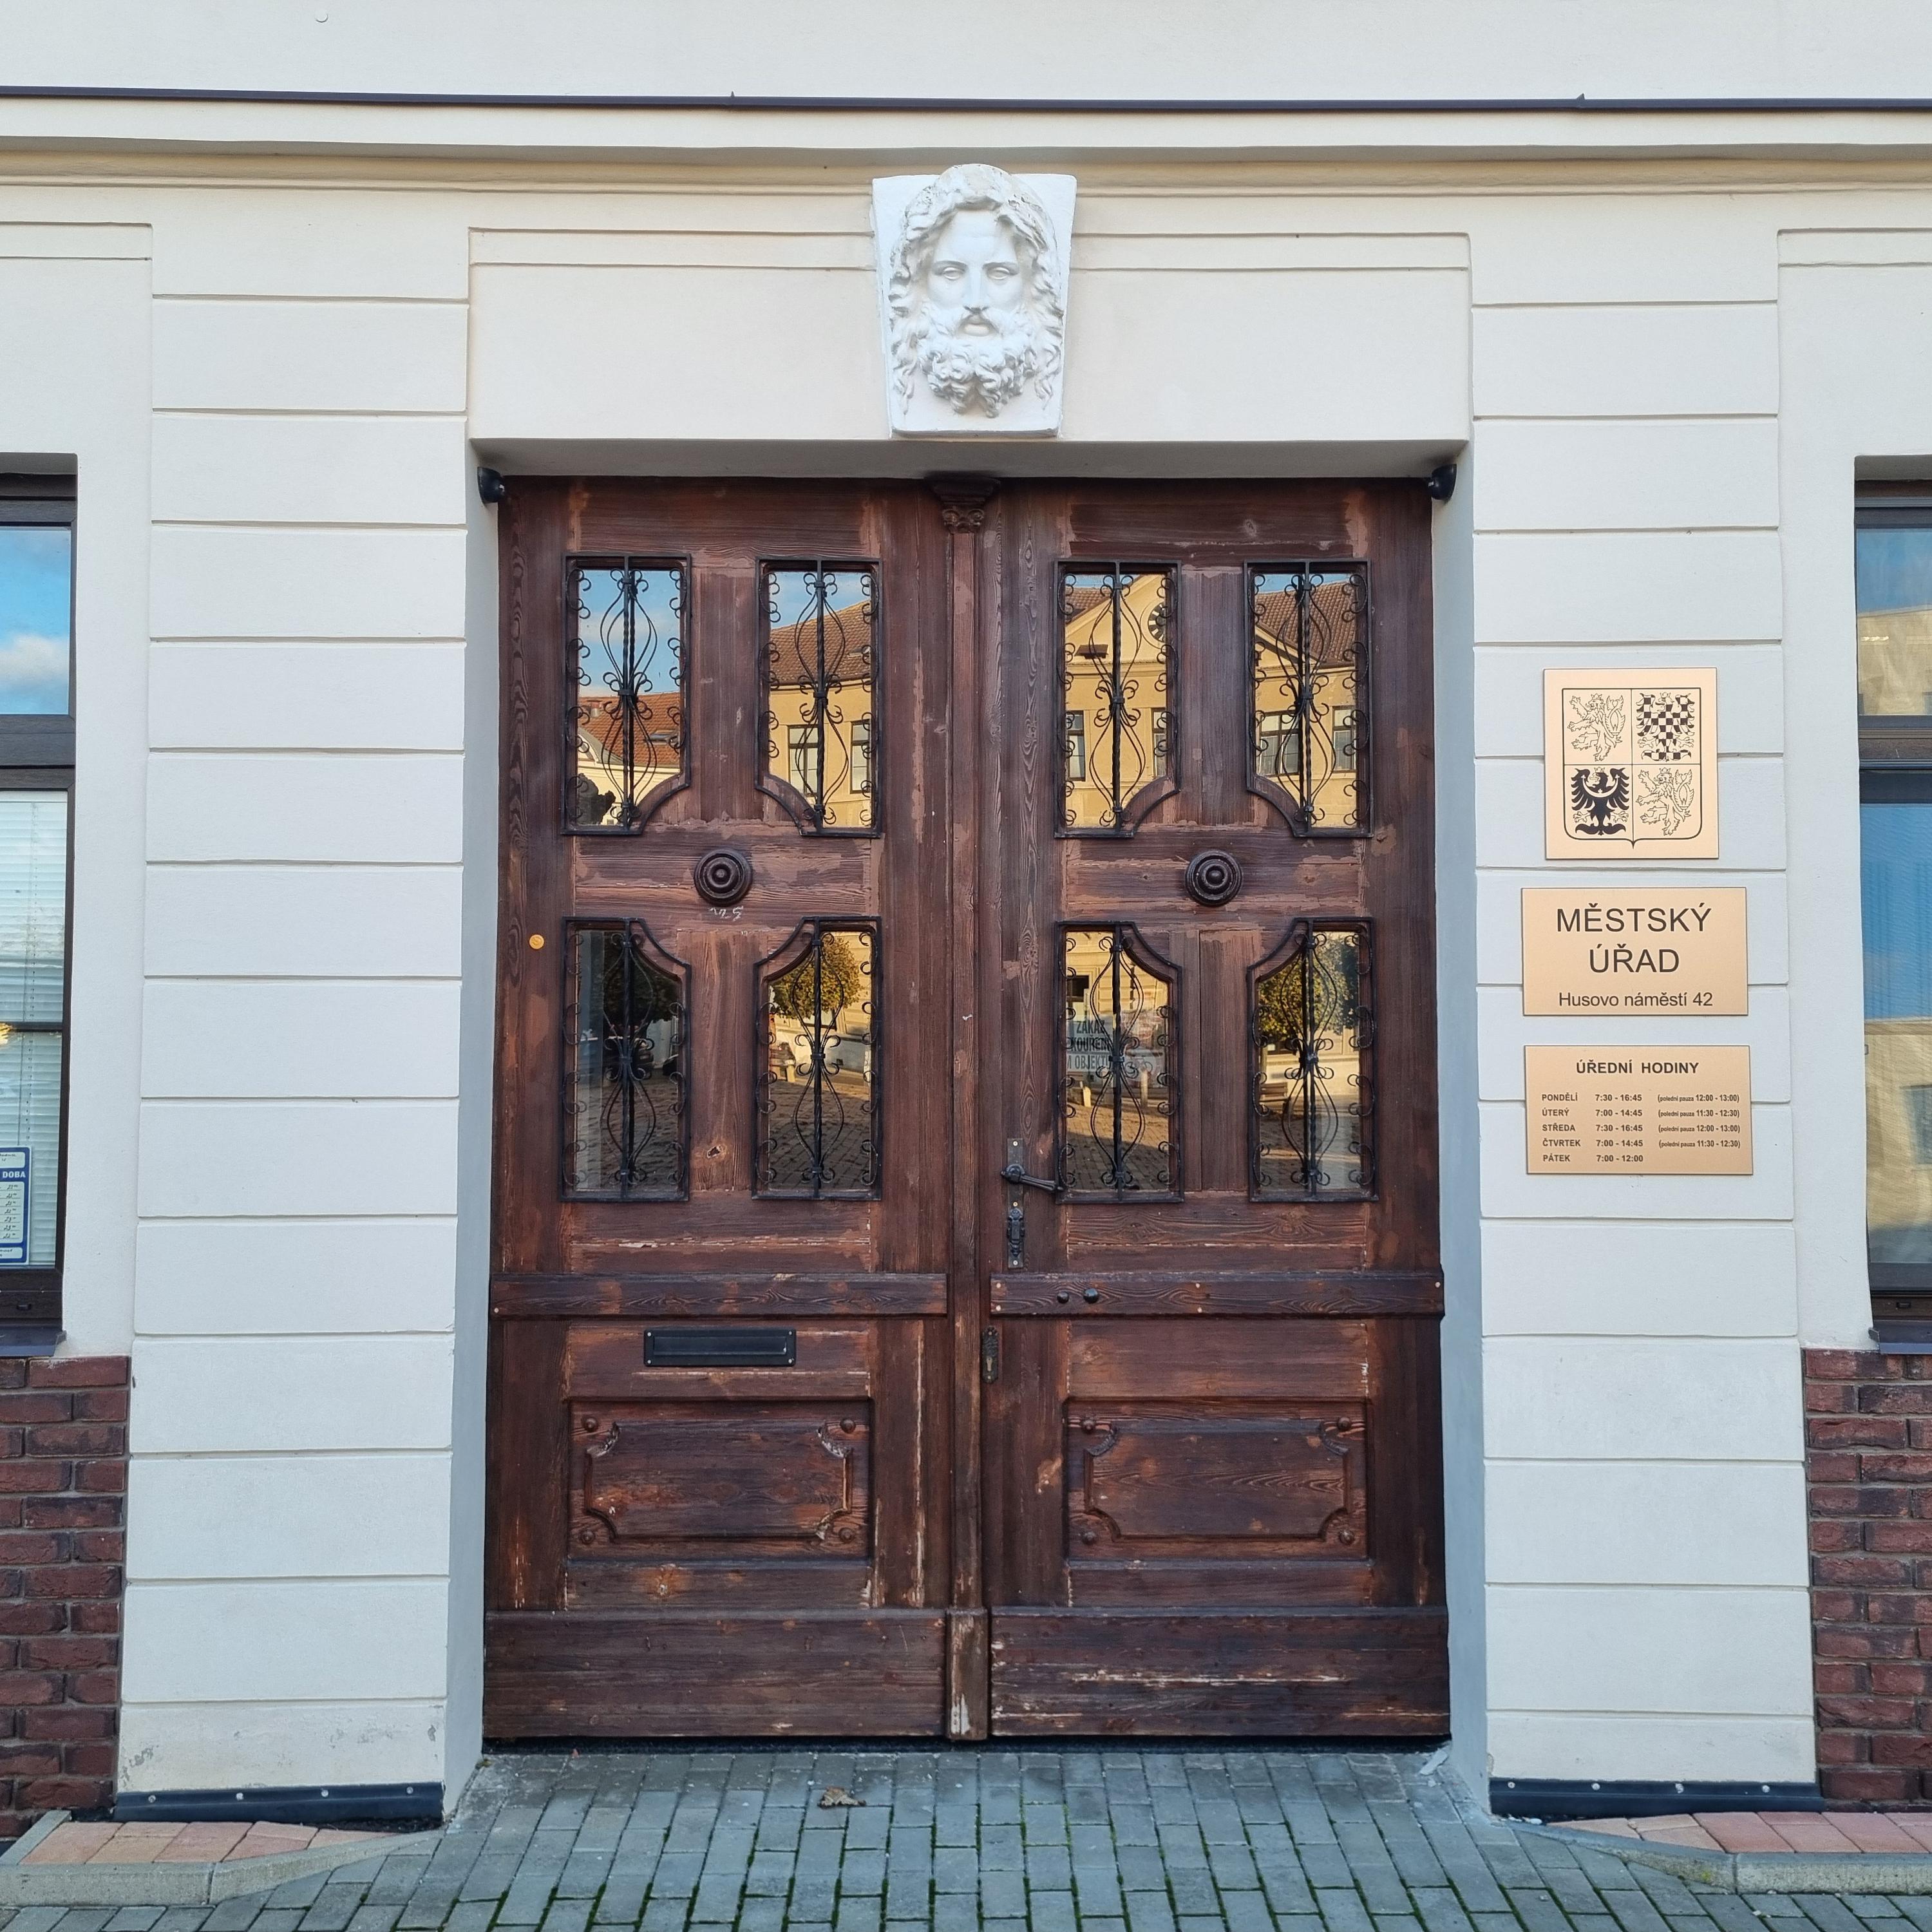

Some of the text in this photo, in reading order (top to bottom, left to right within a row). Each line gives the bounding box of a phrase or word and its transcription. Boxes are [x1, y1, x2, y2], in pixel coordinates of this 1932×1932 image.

[1557, 902, 1712, 933] MĚSTSKÝ
[1589, 943, 1680, 973] ÚŘAD
[1559, 992, 1713, 1007] Husovo náměstí 42
[1576, 1059, 1700, 1074] ÚŘEDNÍ HODINY
[1542, 1092, 1578, 1101] PONDĚLÍ
[1595, 1094, 1613, 1102] 7:30
[1620, 1094, 1642, 1102] 16:45
[1719, 1094, 1739, 1103] 13:00)
[1542, 1107, 1569, 1117] ÚTERÝ
[1719, 1109, 1740, 1118] 12:30)
[1542, 1122, 1576, 1132] STŘEDA
[1720, 1124, 1741, 1133] 13:00)
[1542, 1137, 1581, 1147] ČTVRTEK
[1720, 1140, 1741, 1149] 12:30)
[1542, 1153, 1571, 1162] PÁTEK
